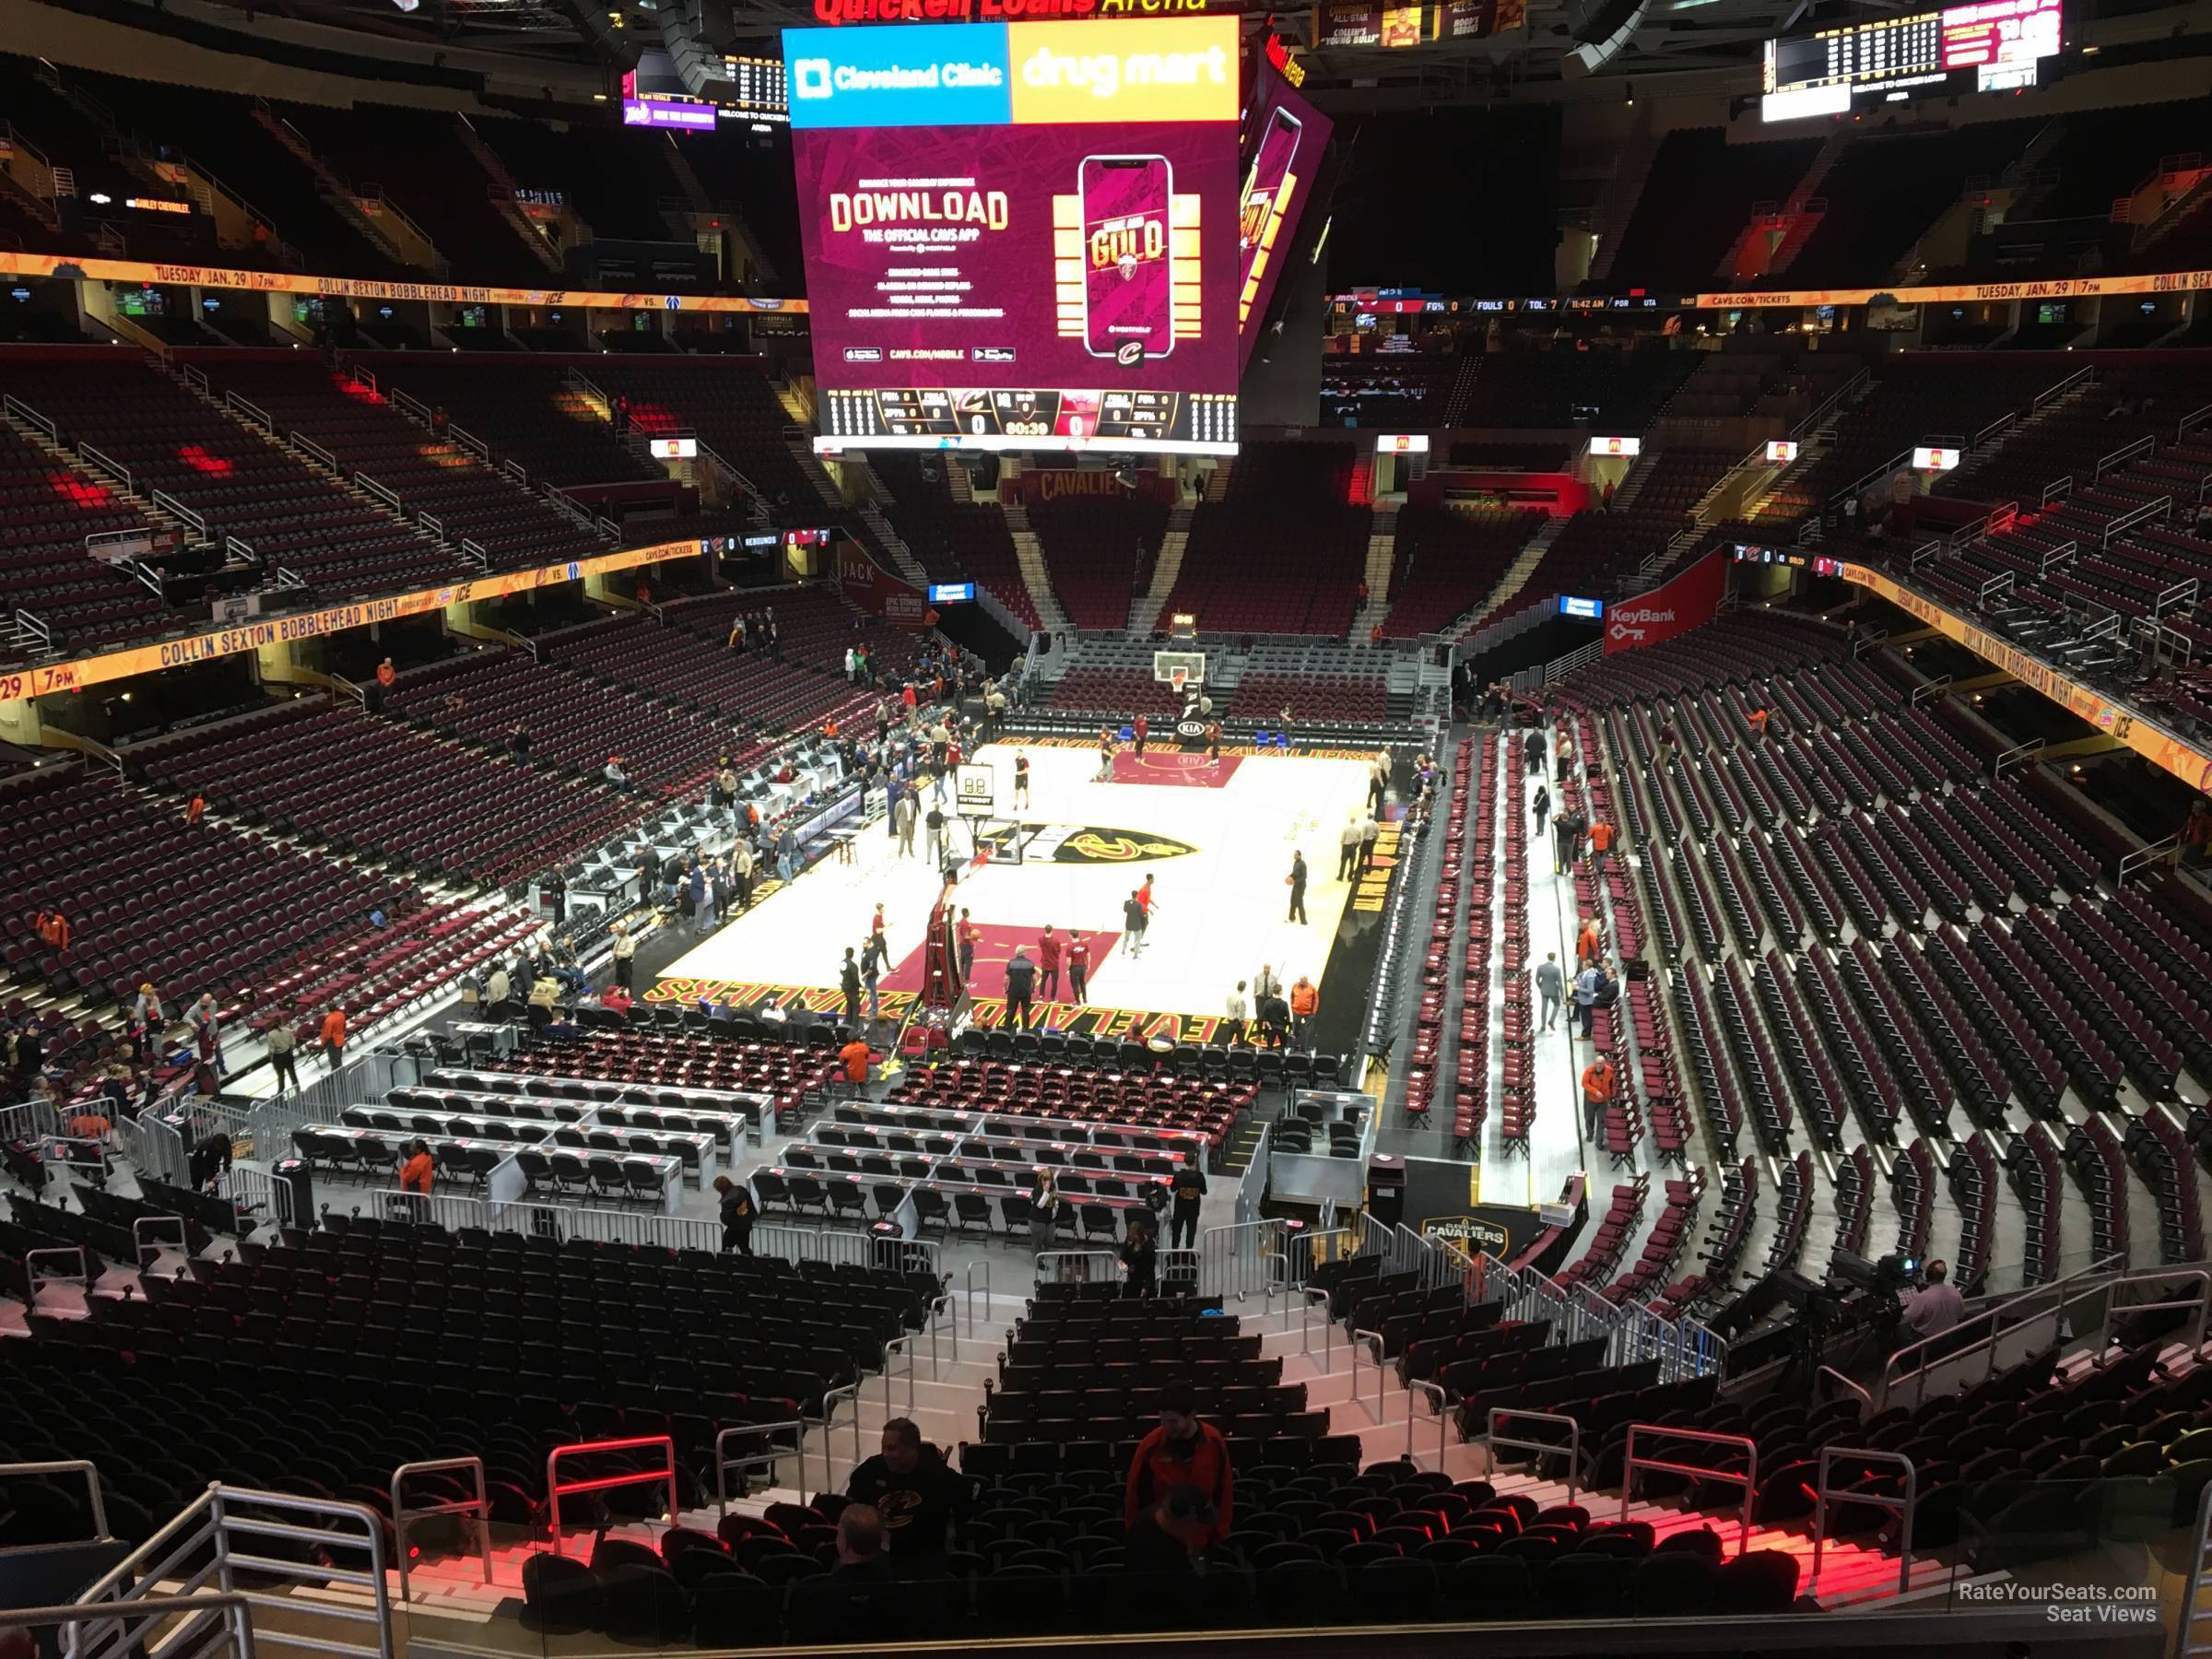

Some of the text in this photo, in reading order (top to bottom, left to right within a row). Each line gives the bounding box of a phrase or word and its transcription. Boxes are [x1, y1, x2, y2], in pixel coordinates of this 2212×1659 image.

[834, 62, 1003, 90] Cleveland Clinic
[1022, 47, 1119, 97] drug
[1126, 45, 1227, 85] mart
[718, 109, 748, 119] WELCOME
[749, 111, 758, 120] TO
[830, 191, 1009, 231] DOWNLOAD
[863, 228, 980, 242] THE OFFICIAL CAVS APP
[156, 266, 275, 288] TUESDAY, JAN. 29 7PM
[2154, 275, 2187, 290] COLLIN
[318, 278, 349, 294] COLLIN
[353, 280, 386, 296] SEXTON
[390, 282, 458, 300] BOBBLEHEAD
[462, 287, 491, 301] NIGHT
[1976, 281, 2100, 299] TUESDAY, JAN. 29 7PM
[1335, 302, 1403, 312] 1Q 0
[1427, 301, 1458, 312] FG% 0
[1477, 300, 1514, 311] FOULS 0
[1529, 300, 1558, 310] TOL: 7
[1571, 300, 1605, 309] 11:42 AM
[1615, 300, 1629, 308] POR
[1643, 299, 1656, 307] UTA
[1712, 295, 1790, 305] CAVS.COM/TICKETS
[914, 425, 921, 434] 7
[971, 415, 985, 435] 0
[1069, 416, 1083, 436] 0
[1156, 428, 1162, 438] 7
[728, 534, 794, 549] 0 0
[746, 536, 776, 546] REBOUNDS
[645, 545, 692, 560] CAVS.COM/TICKETS
[1764, 551, 1771, 562] 0
[843, 560, 874, 582] JACK
[455, 583, 472, 604] ICE
[1610, 608, 1676, 623] KeyBank
[160, 599, 399, 666] COLLIN SEXTON BOBBLEHEAD NIGHT
[1964, 626, 1982, 648] COLLIN
[1983, 631, 2006, 665] SEXTON
[2007, 651, 2049, 694] BOBBLEHEAD
[2051, 676, 2073, 708] NIGHT
[0, 670, 74, 700] 29 7PM
[1181, 724, 1203, 734] KIA
[2113, 716, 2133, 739] ICE
[1446, 1222, 1485, 1230] CLEVELAND
[1427, 1225, 1504, 1244] CAVALIERS
